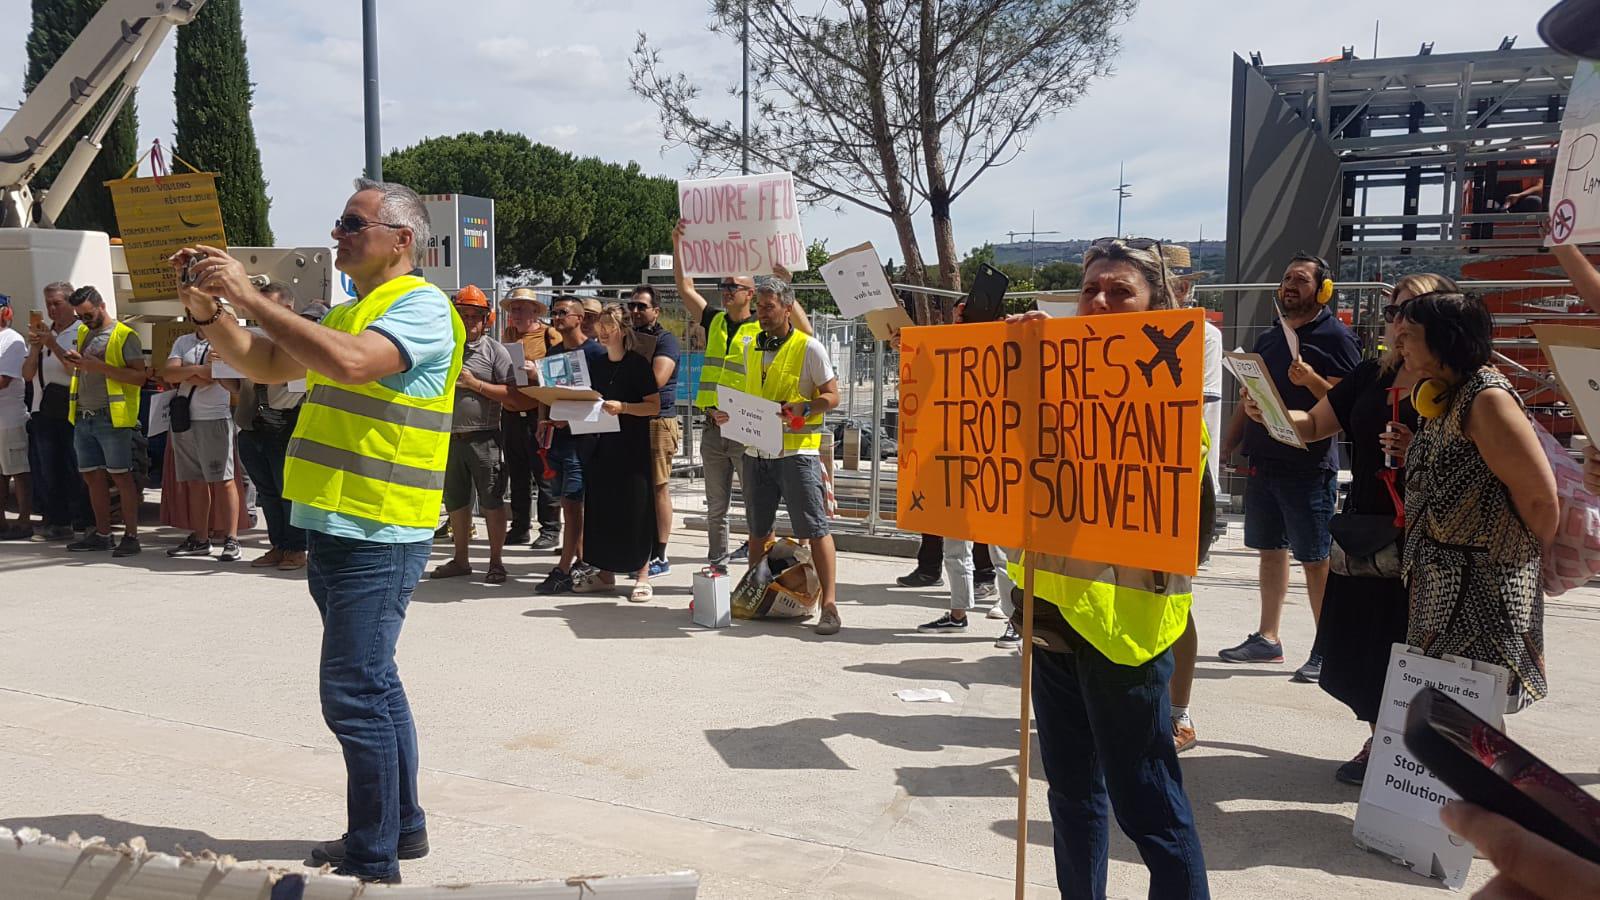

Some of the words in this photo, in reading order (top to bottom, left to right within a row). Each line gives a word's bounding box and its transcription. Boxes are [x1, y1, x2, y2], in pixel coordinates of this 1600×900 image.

[681, 184, 748, 225] COUVRE
[758, 179, 793, 221] FEU
[442, 235, 451, 267] 1
[464, 227, 482, 237] terminal
[483, 230, 488, 249] 1
[681, 237, 762, 273] DORMONS
[934, 341, 1021, 399] TROP
[1040, 324, 1130, 400] PRÈS
[933, 400, 1021, 455] TROP
[1038, 400, 1198, 466] BRUYANT
[934, 455, 1022, 515] TROP
[1029, 458, 1192, 538] SOUVENT
[1402, 672, 1422, 687] Stop
[1424, 679, 1436, 689] au
[1438, 681, 1461, 696] bruit
[1462, 686, 1480, 700] des
[1394, 754, 1425, 776] Stop
